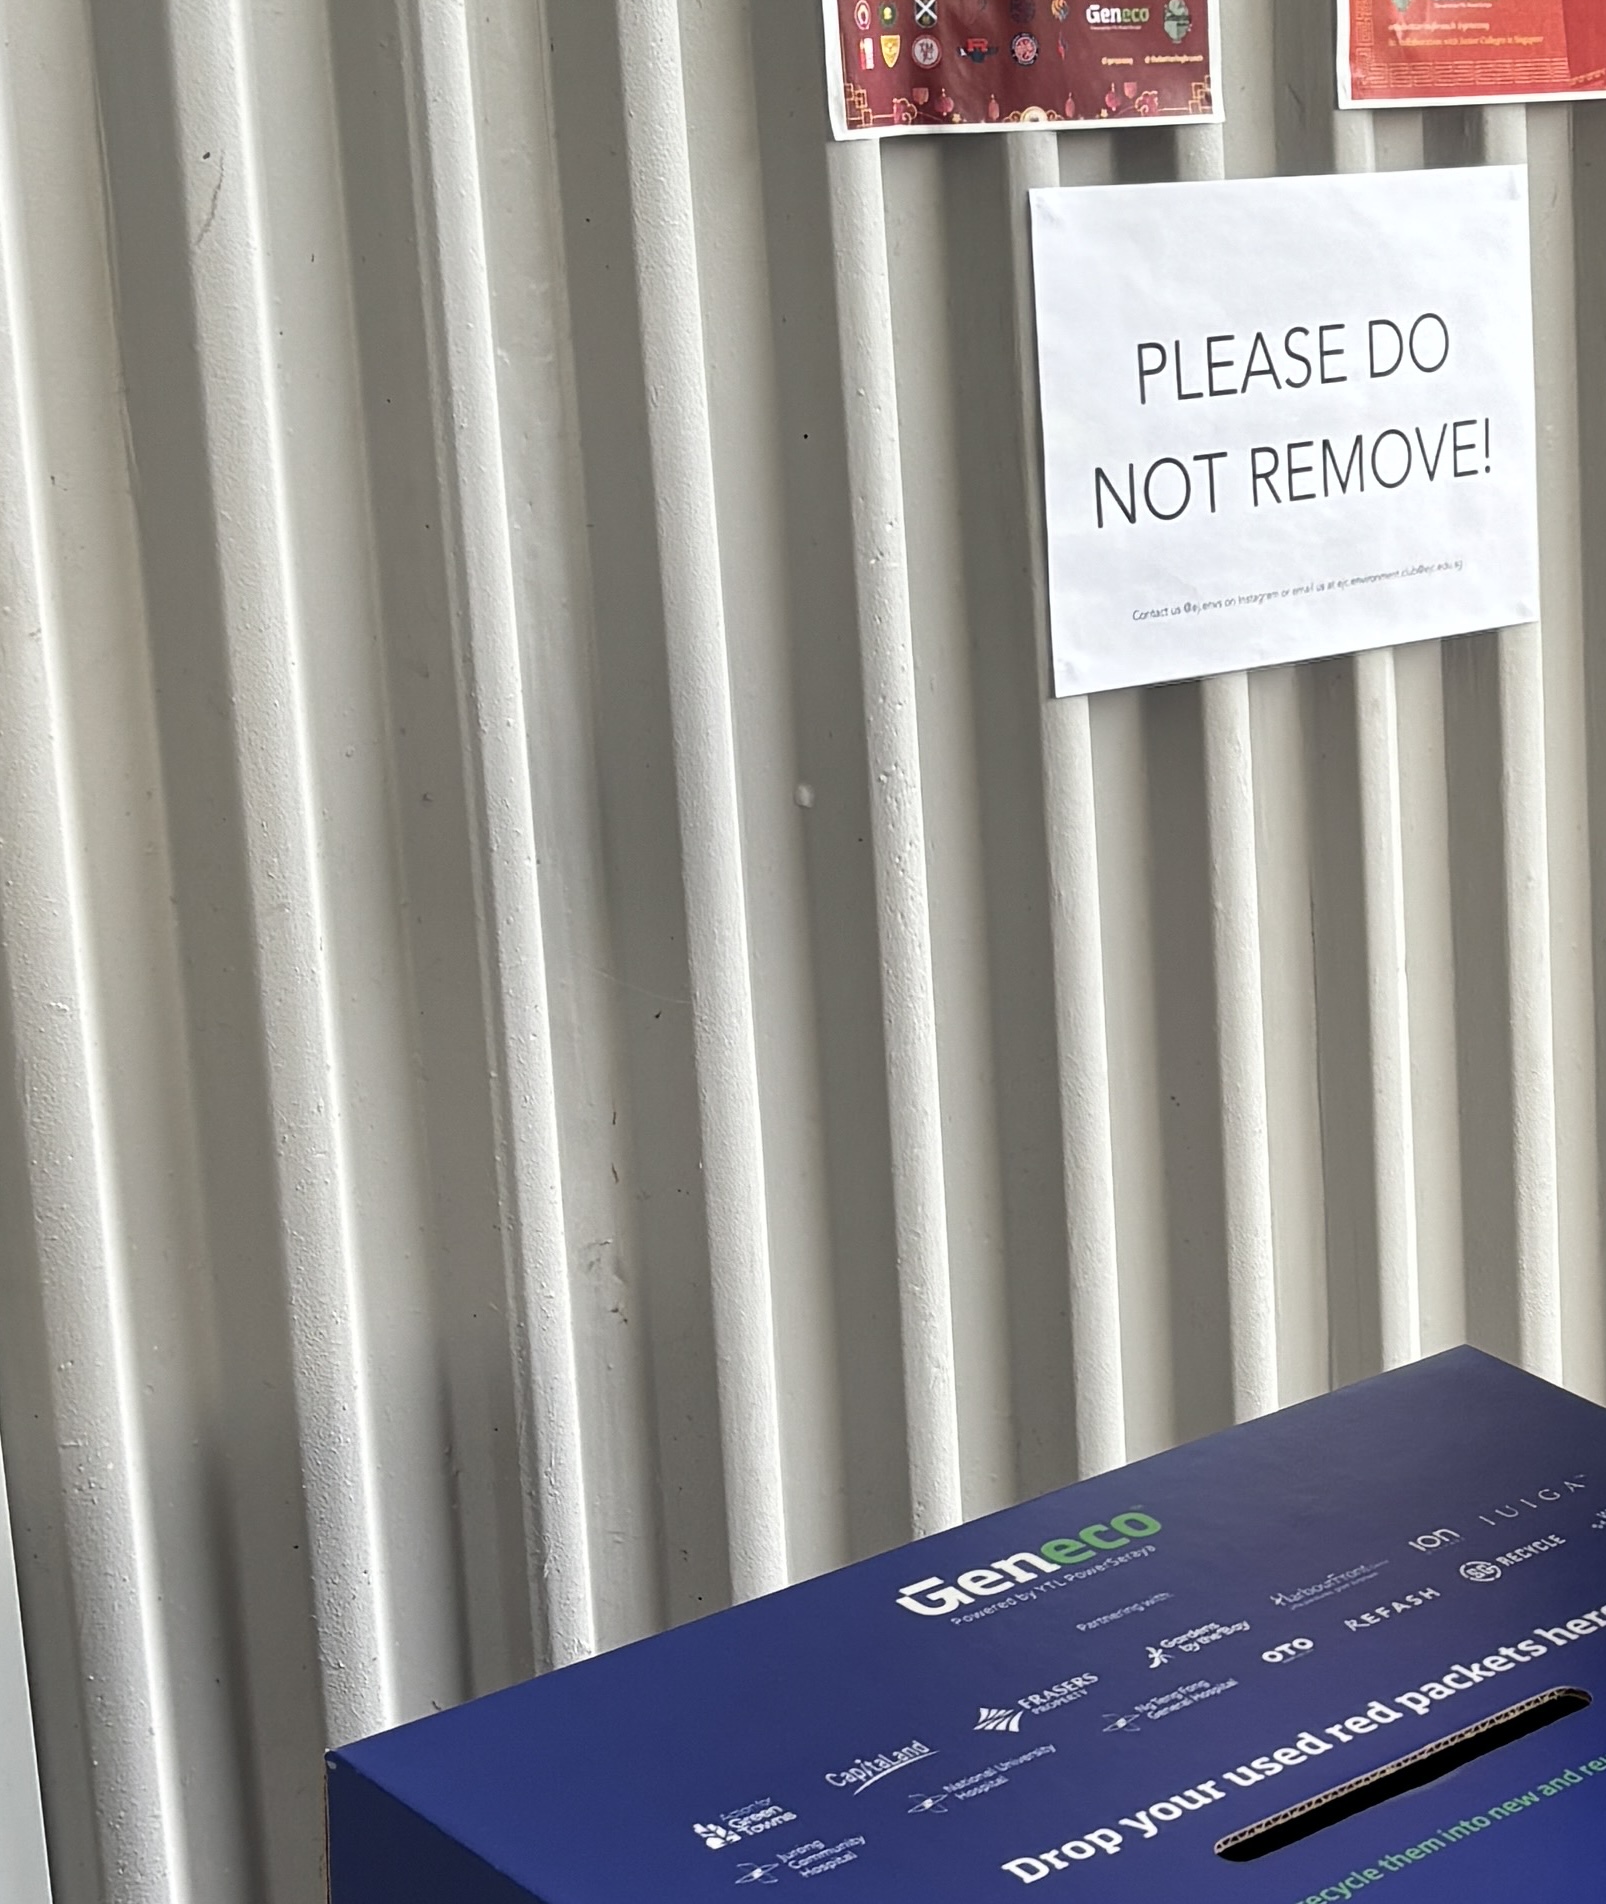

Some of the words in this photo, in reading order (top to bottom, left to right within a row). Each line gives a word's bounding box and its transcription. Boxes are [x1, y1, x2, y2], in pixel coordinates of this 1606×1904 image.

[1086, 4, 1149, 23] Geneco
[1137, 324, 1347, 404] PLEASE
[1368, 313, 1449, 379] DO
[1095, 452, 1227, 529] NOT
[1251, 418, 1491, 507] REMOVE!
[896, 1511, 1162, 1618] Geneco
[1496, 1534, 1566, 1568] RECYCLE
[1344, 1587, 1441, 1632] REFASH
[1262, 1638, 1314, 1663] OTO
[1018, 1672, 1099, 1713] FRASERS
[824, 1740, 931, 1789] CapitaLand
[1001, 1829, 1123, 1885] Drop
[1122, 1781, 1231, 1839] your
[1222, 1733, 1334, 1789] used
[1324, 1701, 1404, 1745] red
[1394, 1633, 1548, 1716] packets
[1378, 1836, 1441, 1877] them
[1440, 1814, 1491, 1845] into
[1488, 1790, 1541, 1822] new
[1536, 1767, 1583, 1798] and
